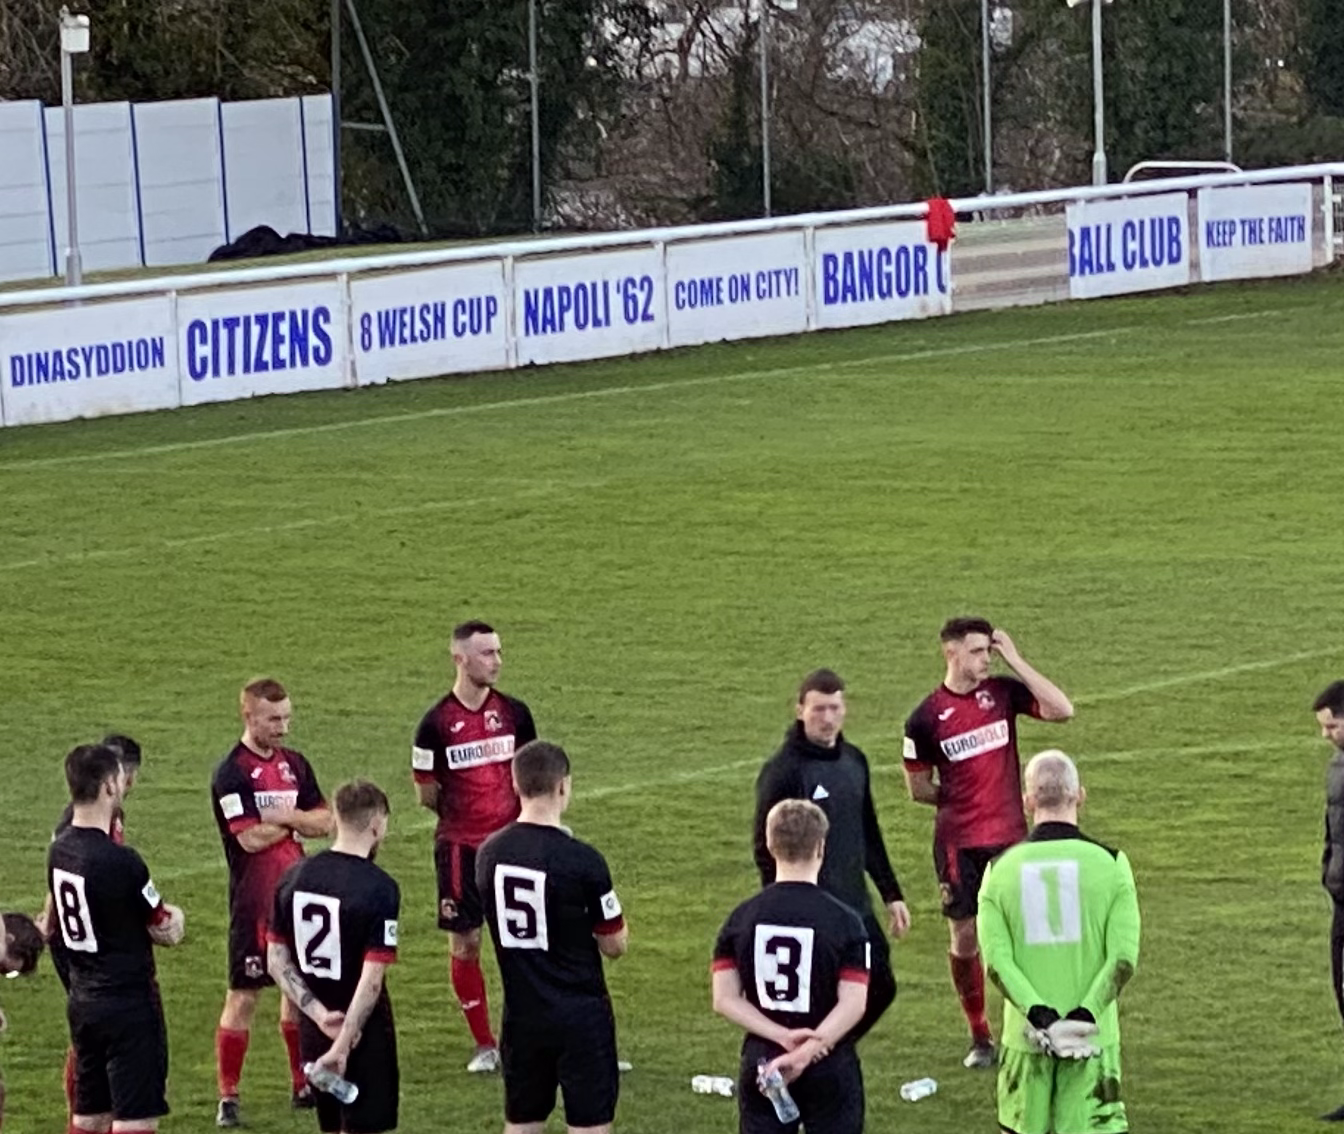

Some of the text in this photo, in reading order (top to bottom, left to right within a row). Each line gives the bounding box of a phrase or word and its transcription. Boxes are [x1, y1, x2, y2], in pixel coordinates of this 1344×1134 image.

[1122, 215, 1183, 272] CLUB
[1205, 214, 1305, 249] KEEP THE FAITH
[674, 267, 799, 311] COME ON CITY!
[822, 243, 929, 306] BANGOR
[359, 294, 498, 353] 8 WELSH CUP
[523, 279, 611, 337] NAPOLI
[9, 335, 165, 388] DINASYDDION
[186, 305, 333, 382] CITIZENS
[60, 880, 87, 942] 8
[503, 876, 537, 939] 5
[1040, 866, 1064, 935] 1
[302, 903, 331, 969] 2
[765, 935, 802, 1002] 3
